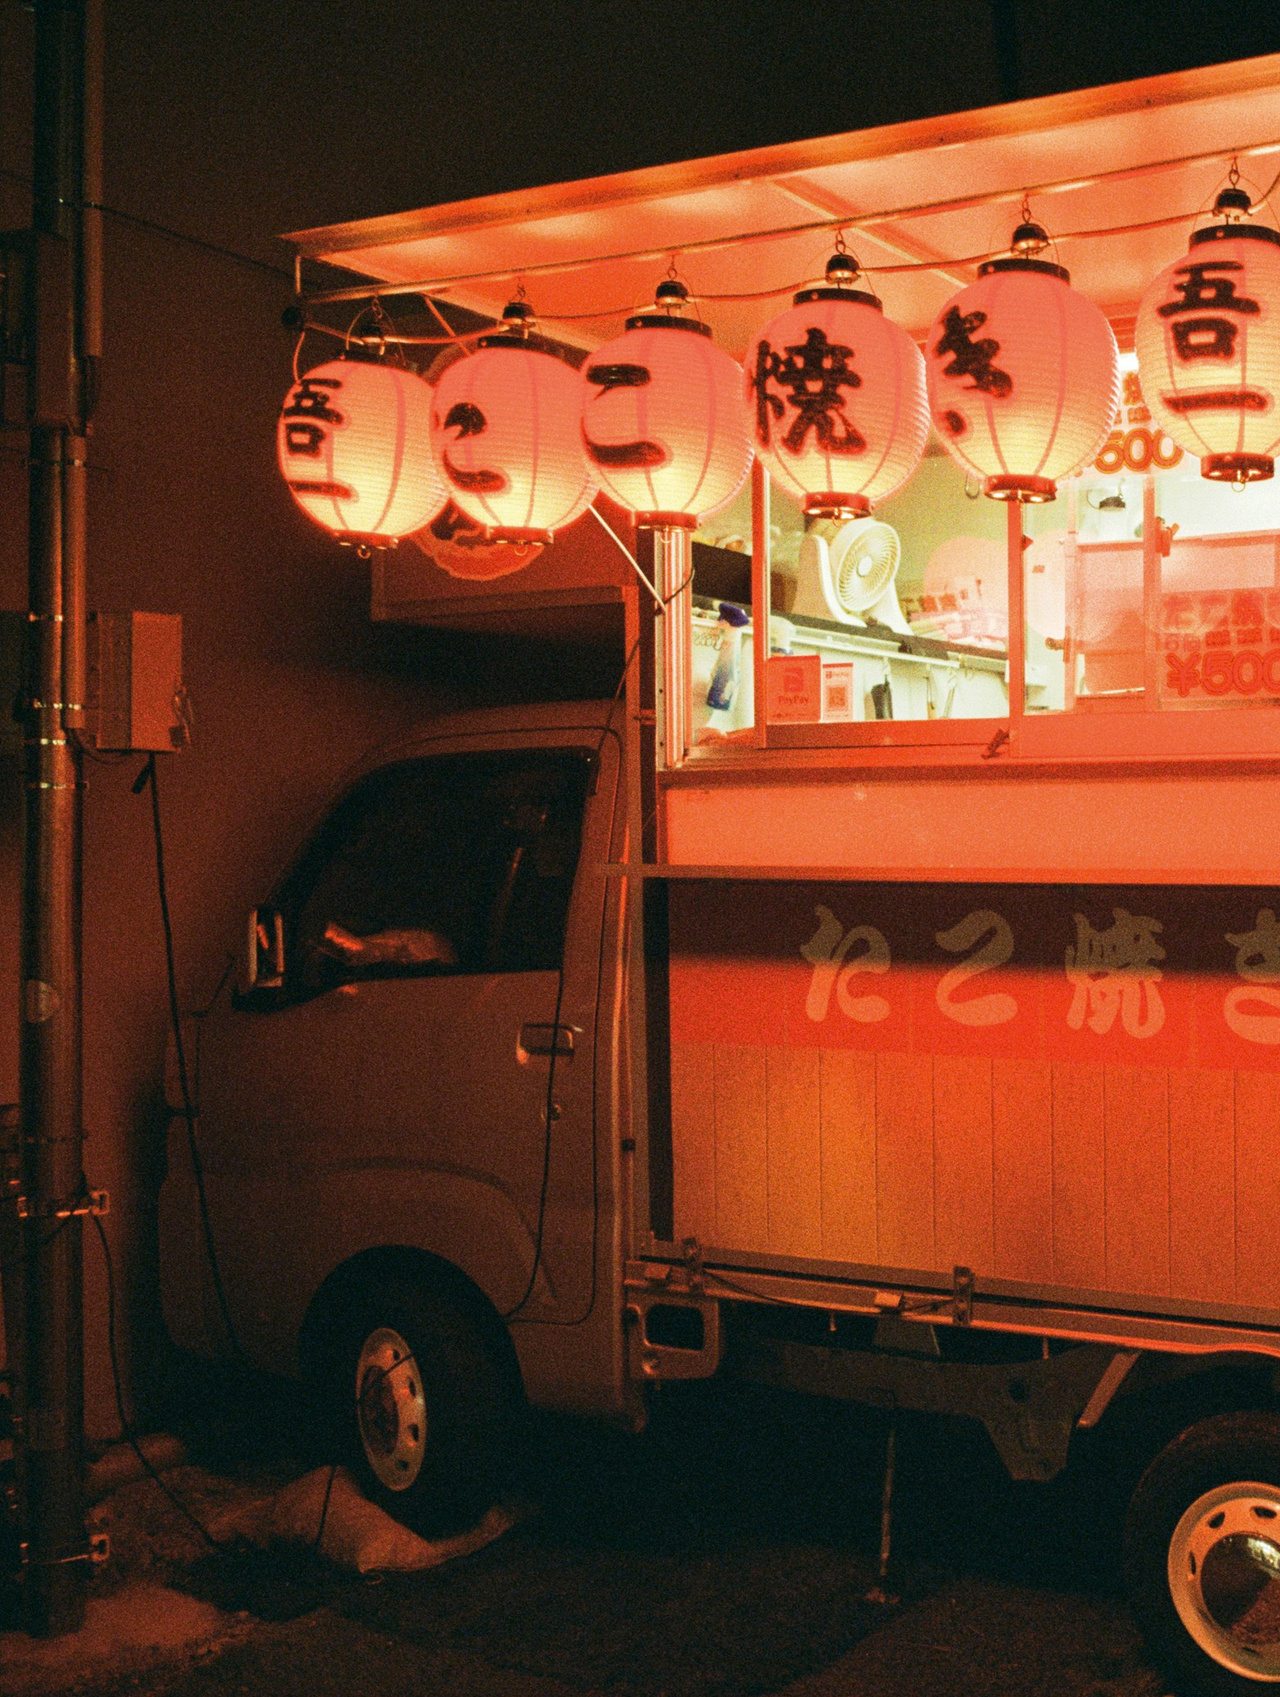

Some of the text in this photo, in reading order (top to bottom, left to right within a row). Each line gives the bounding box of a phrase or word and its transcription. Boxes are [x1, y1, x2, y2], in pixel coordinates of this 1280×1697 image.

[749, 327, 867, 454] 焼
[1156, 260, 1269, 412] 吾一
[281, 377, 352, 499] 吾一
[778, 695, 809, 705] PayPay
